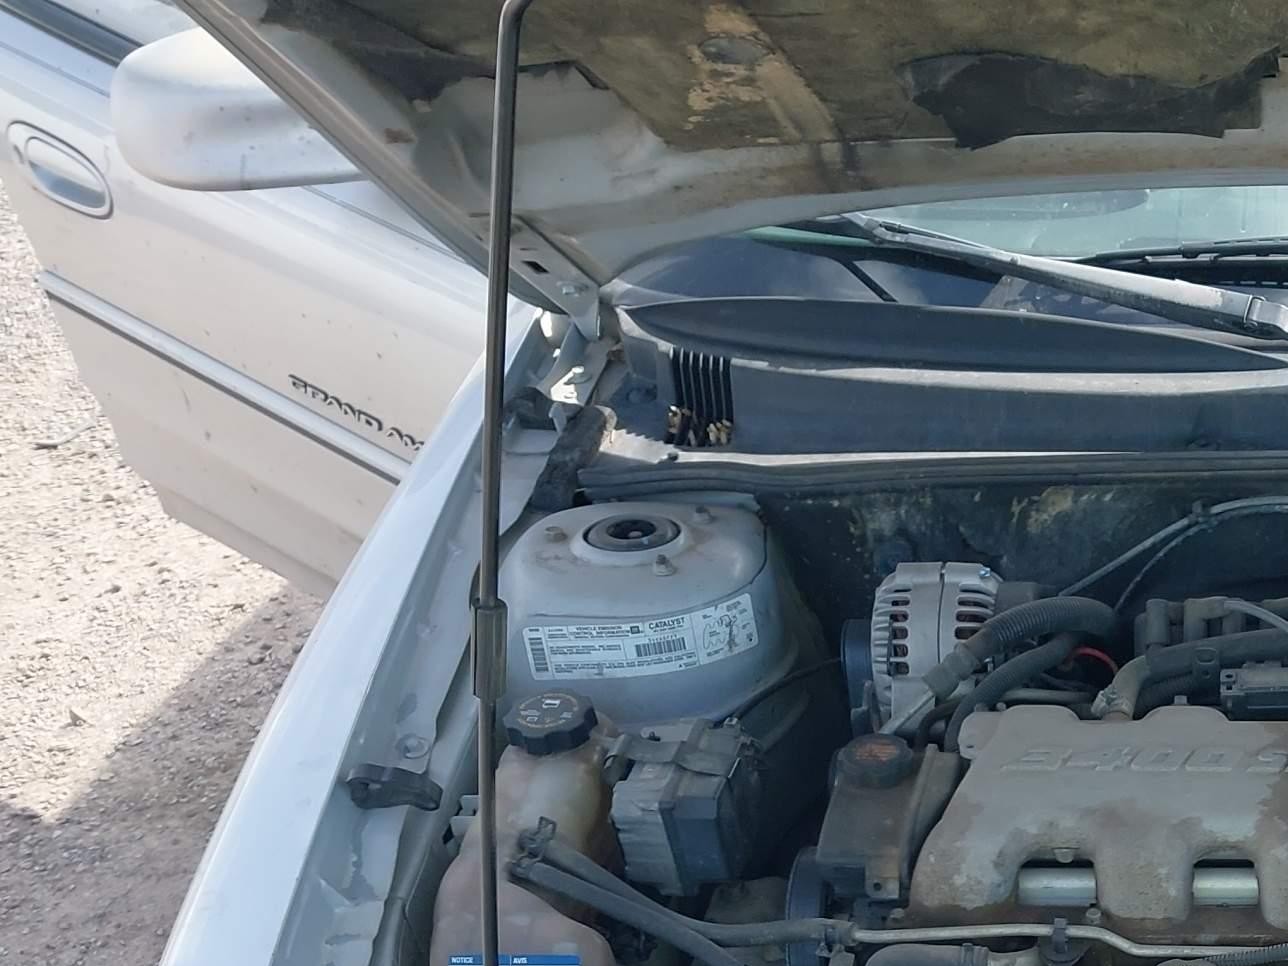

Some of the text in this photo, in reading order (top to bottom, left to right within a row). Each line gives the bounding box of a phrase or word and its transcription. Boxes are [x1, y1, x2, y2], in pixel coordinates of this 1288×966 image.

[648, 617, 686, 629] CATALYST
[1000, 748, 1240, 772] 3400
[451, 956, 474, 964] NOTICE
